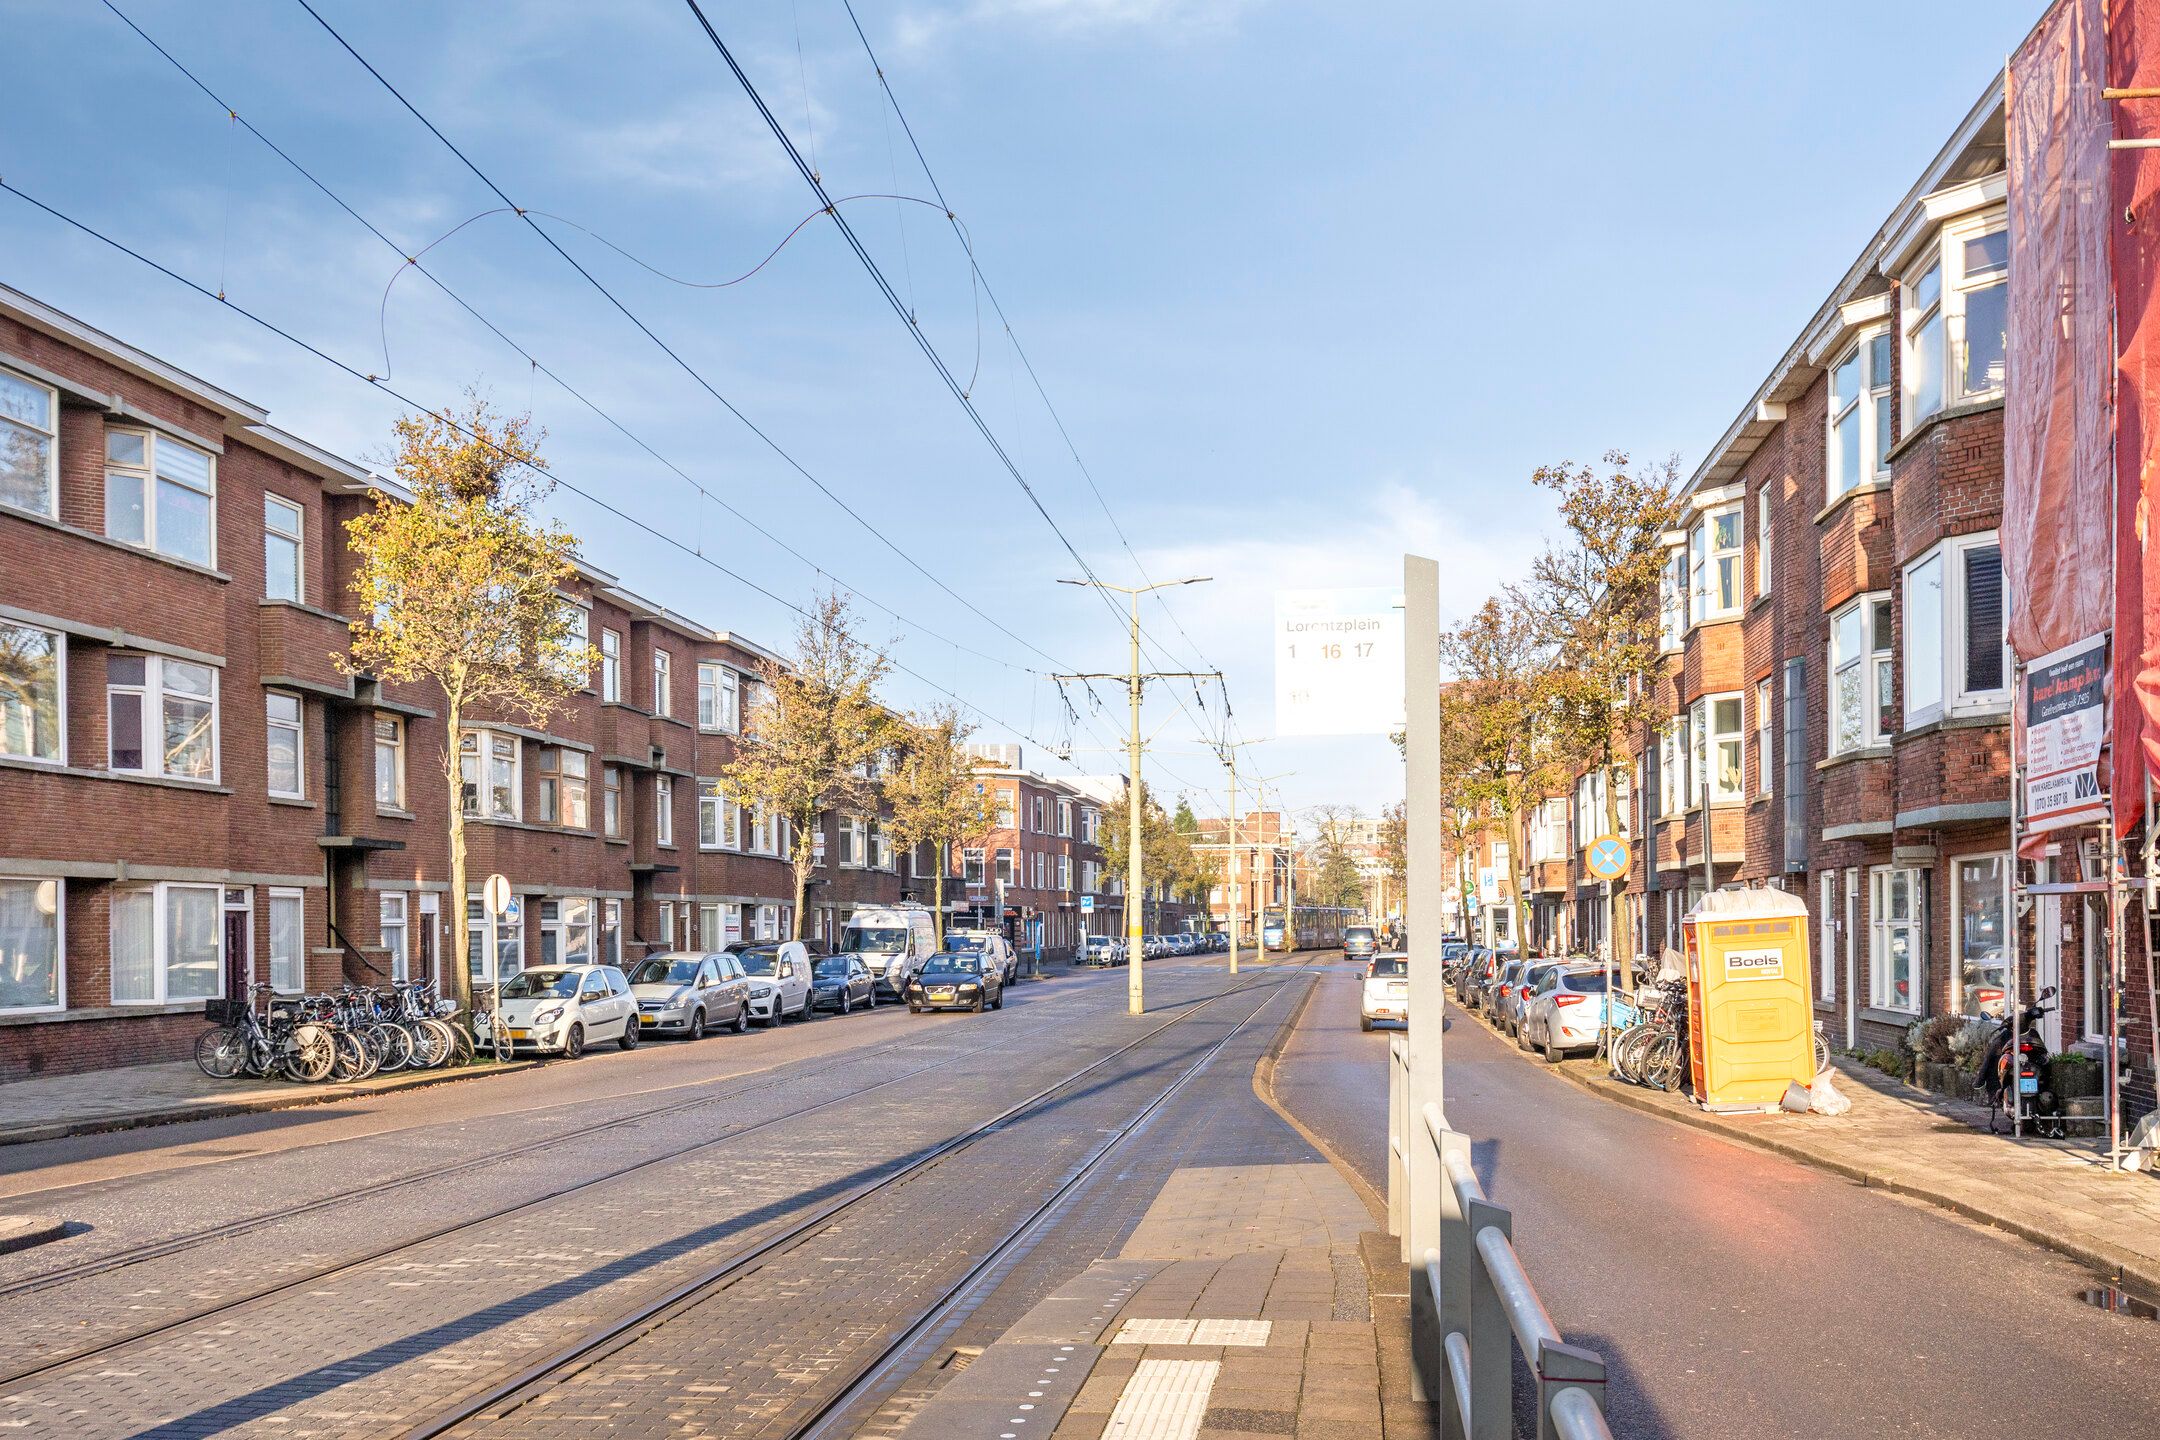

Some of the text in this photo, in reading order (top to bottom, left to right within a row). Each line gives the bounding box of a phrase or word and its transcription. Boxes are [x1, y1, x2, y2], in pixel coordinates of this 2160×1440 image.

[1286, 618, 1381, 634] Lorentzplein
[1288, 642, 1374, 659] 1 16 17
[2055, 673, 2085, 692] kamp
[1729, 955, 1779, 967] Boels
